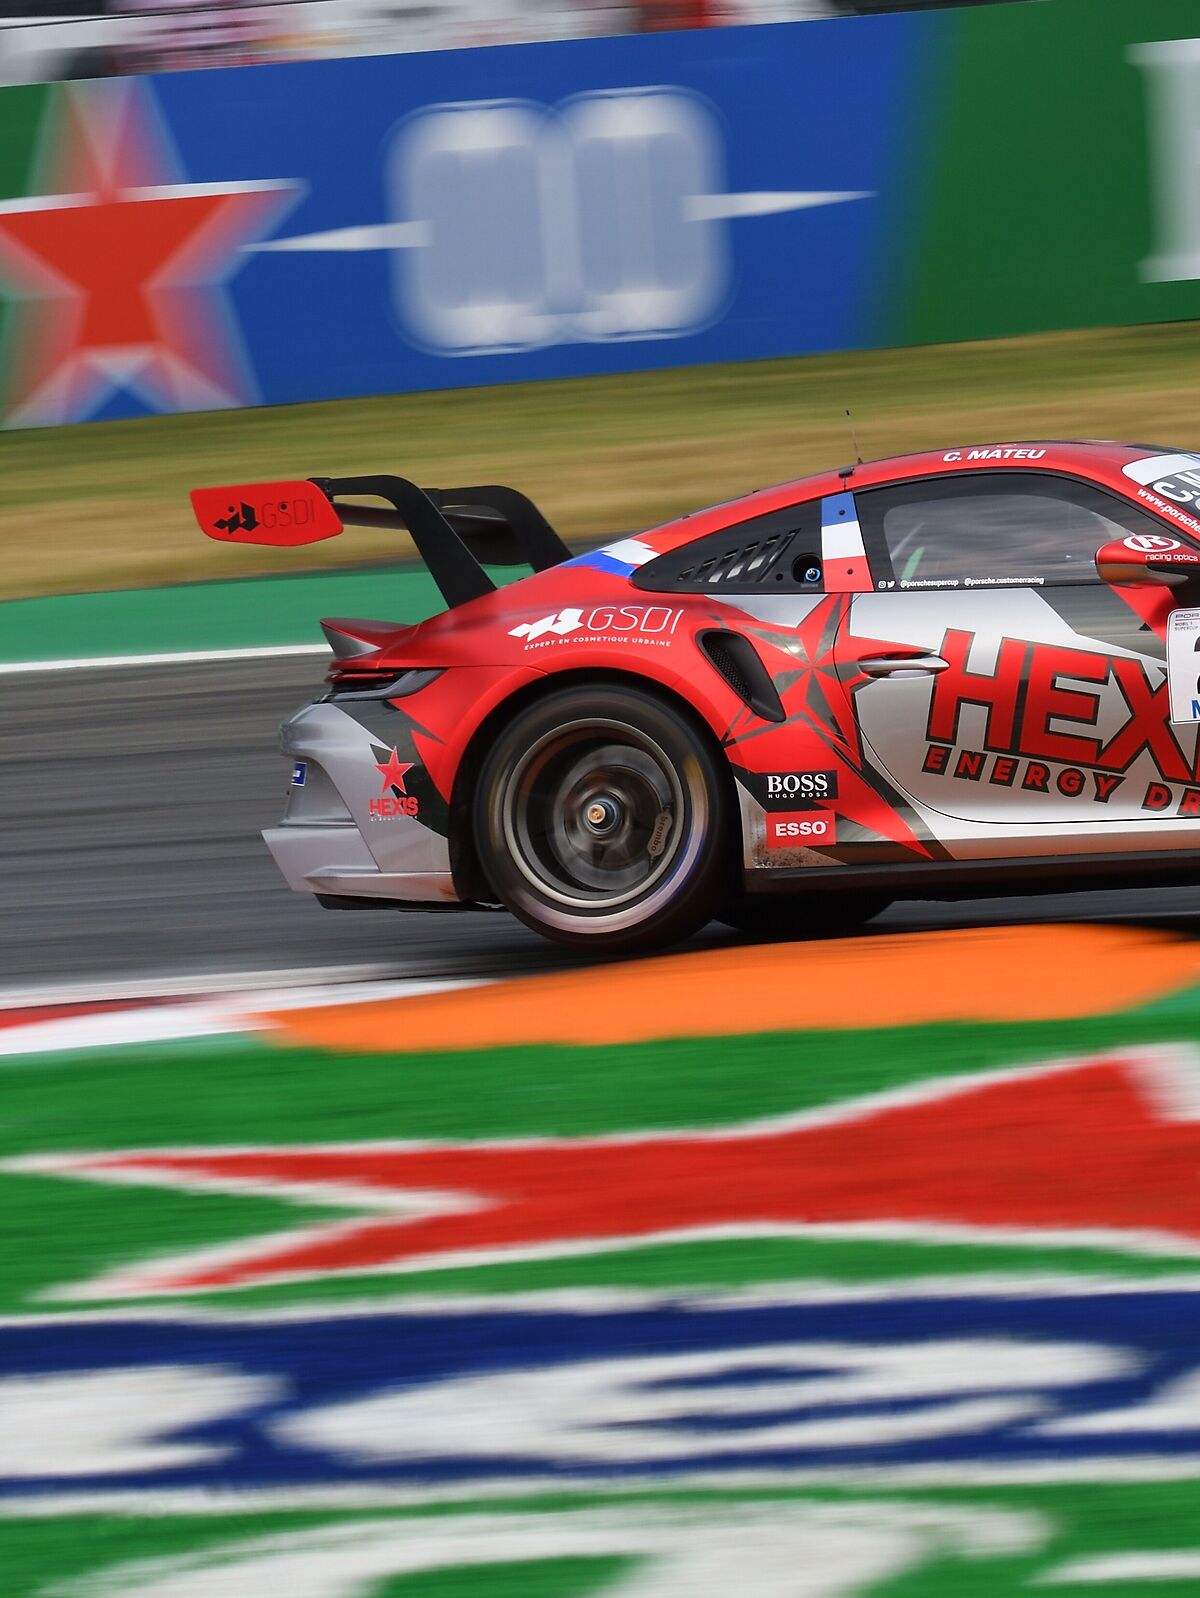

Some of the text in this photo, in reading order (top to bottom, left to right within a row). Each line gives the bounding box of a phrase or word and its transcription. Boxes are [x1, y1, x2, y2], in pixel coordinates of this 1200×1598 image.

[943, 449, 1047, 462] C. MATEU
[261, 499, 316, 529] GSDI
[1145, 553, 1198, 562] racing optics
[900, 579, 959, 588] @porschesupercup
[587, 606, 684, 635] GSDI
[524, 640, 556, 651] EXPERT
[631, 638, 671, 647] URBAINE
[767, 774, 828, 793] BOSS
[922, 744, 1127, 804] ENERGY
[369, 796, 419, 817] HEXIS
[651, 816, 669, 852] brembo
[775, 821, 827, 837] ESSO
